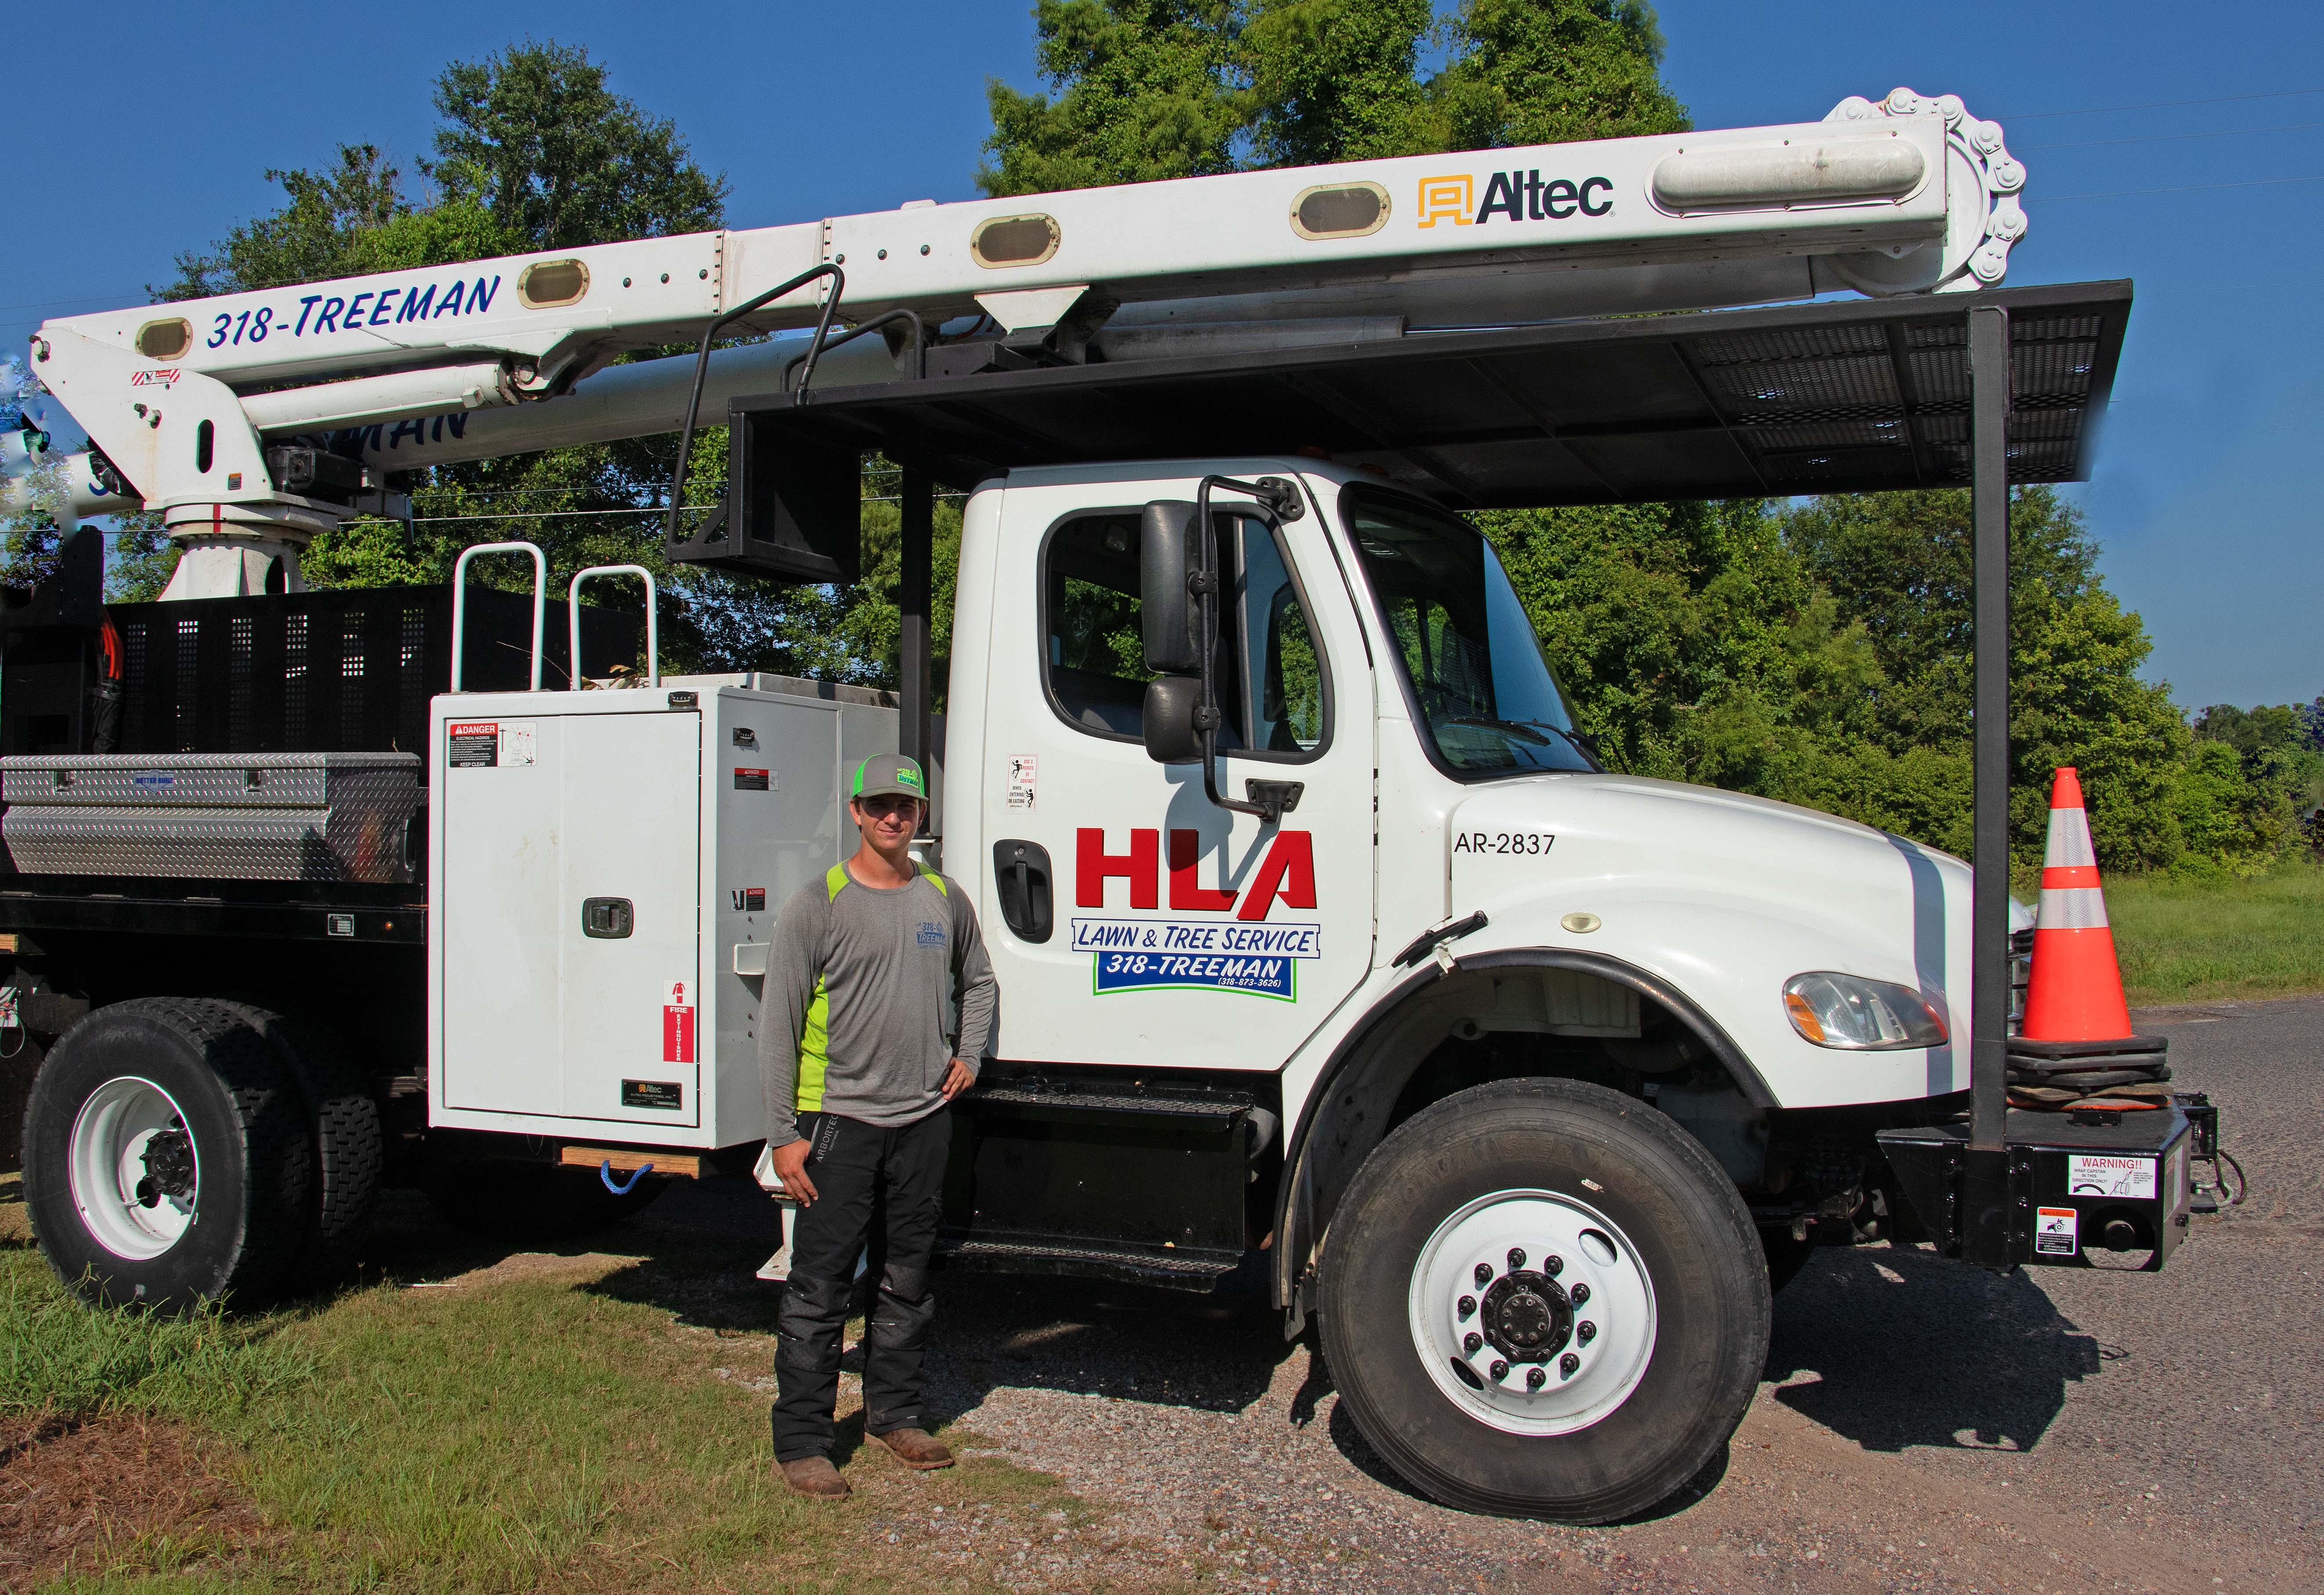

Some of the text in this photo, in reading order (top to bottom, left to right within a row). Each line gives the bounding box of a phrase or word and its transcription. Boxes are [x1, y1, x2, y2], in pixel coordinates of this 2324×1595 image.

[1476, 169, 1613, 224] Altec
[206, 275, 501, 349] 318-TREEMAN
[463, 725, 495, 734] DANGER
[1454, 832, 1555, 855] AR-2837
[1076, 828, 1318, 921] HLA
[1077, 923, 1314, 952] LAWN & TREE SERVICE
[1106, 954, 1282, 979] 318-TREEMAN
[1218, 977, 1281, 988] (318-873-3626)
[646, 1085, 662, 1093] Altec
[2082, 1157, 2142, 1169] WARNING!!
